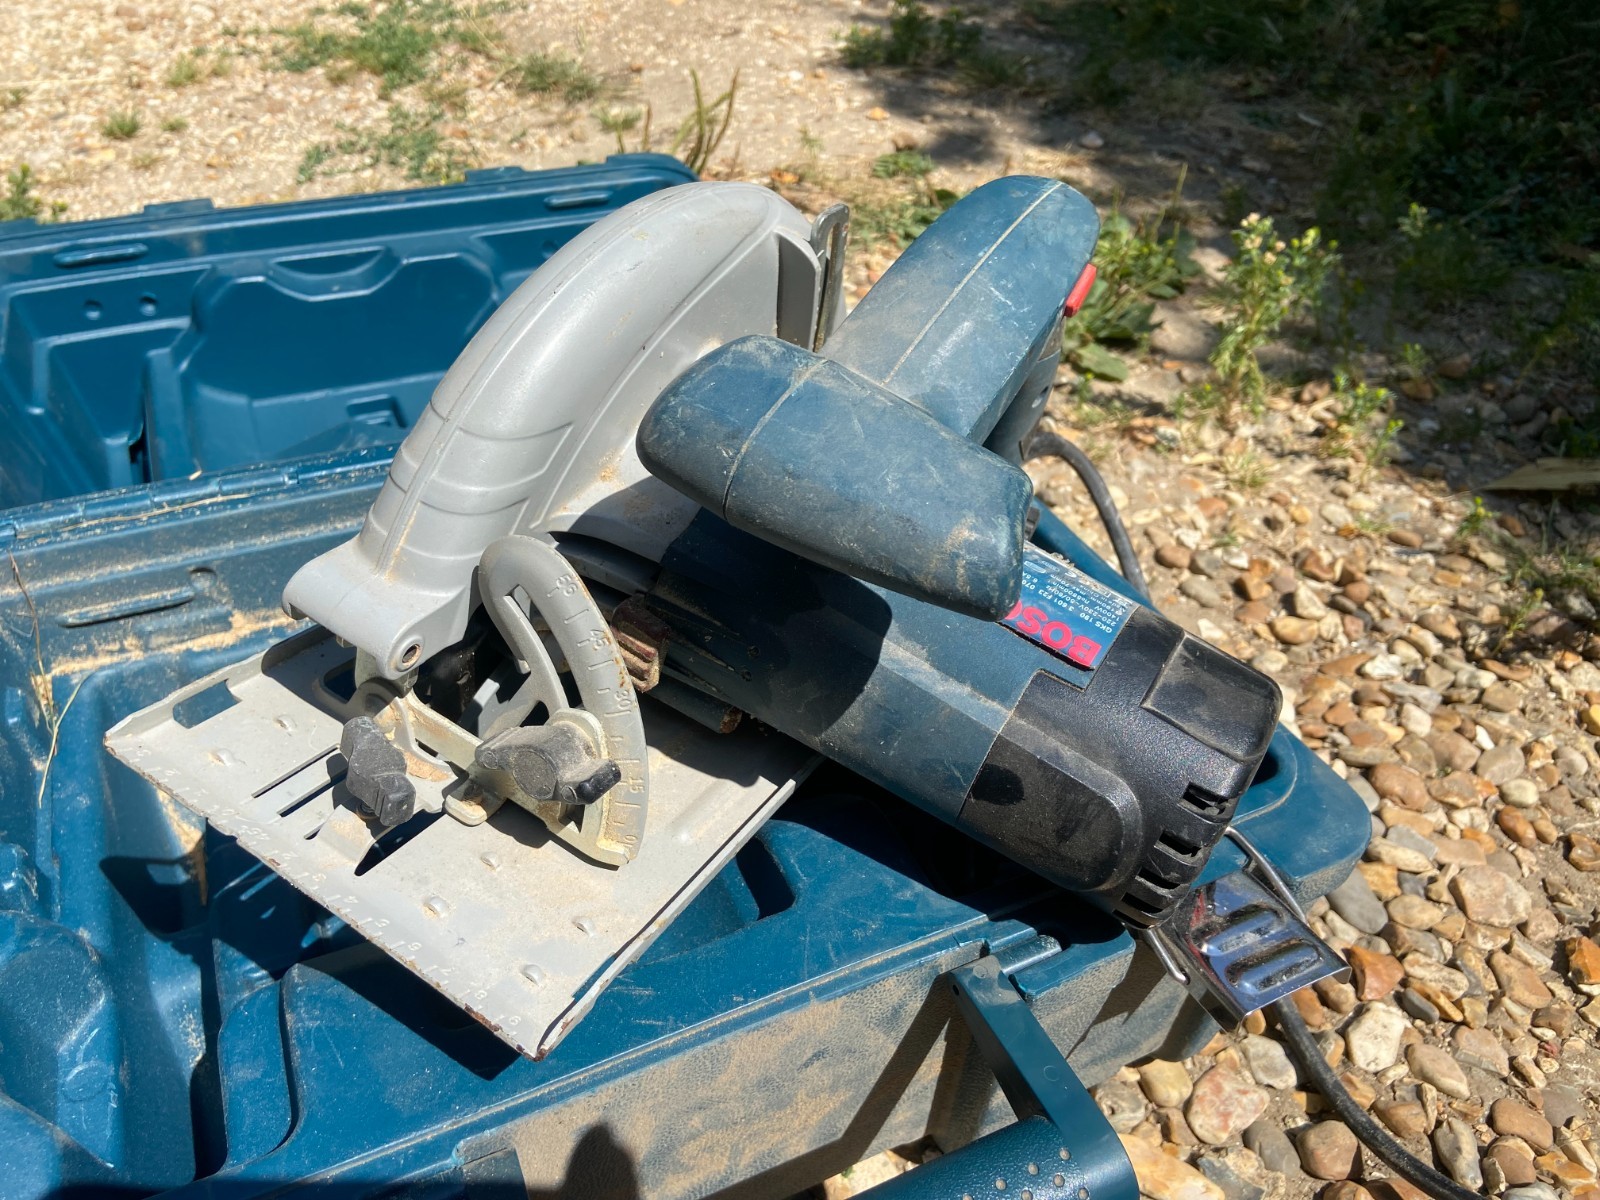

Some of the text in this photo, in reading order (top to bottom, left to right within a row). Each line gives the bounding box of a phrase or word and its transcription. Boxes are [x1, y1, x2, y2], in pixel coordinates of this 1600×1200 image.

[1038, 589, 1053, 600] F23
[1053, 598, 1068, 608] 601
[1080, 612, 1093, 623] 190
[1095, 621, 1112, 633] GKS
[1004, 600, 1102, 668] BOS
[629, 776, 645, 793] 15
